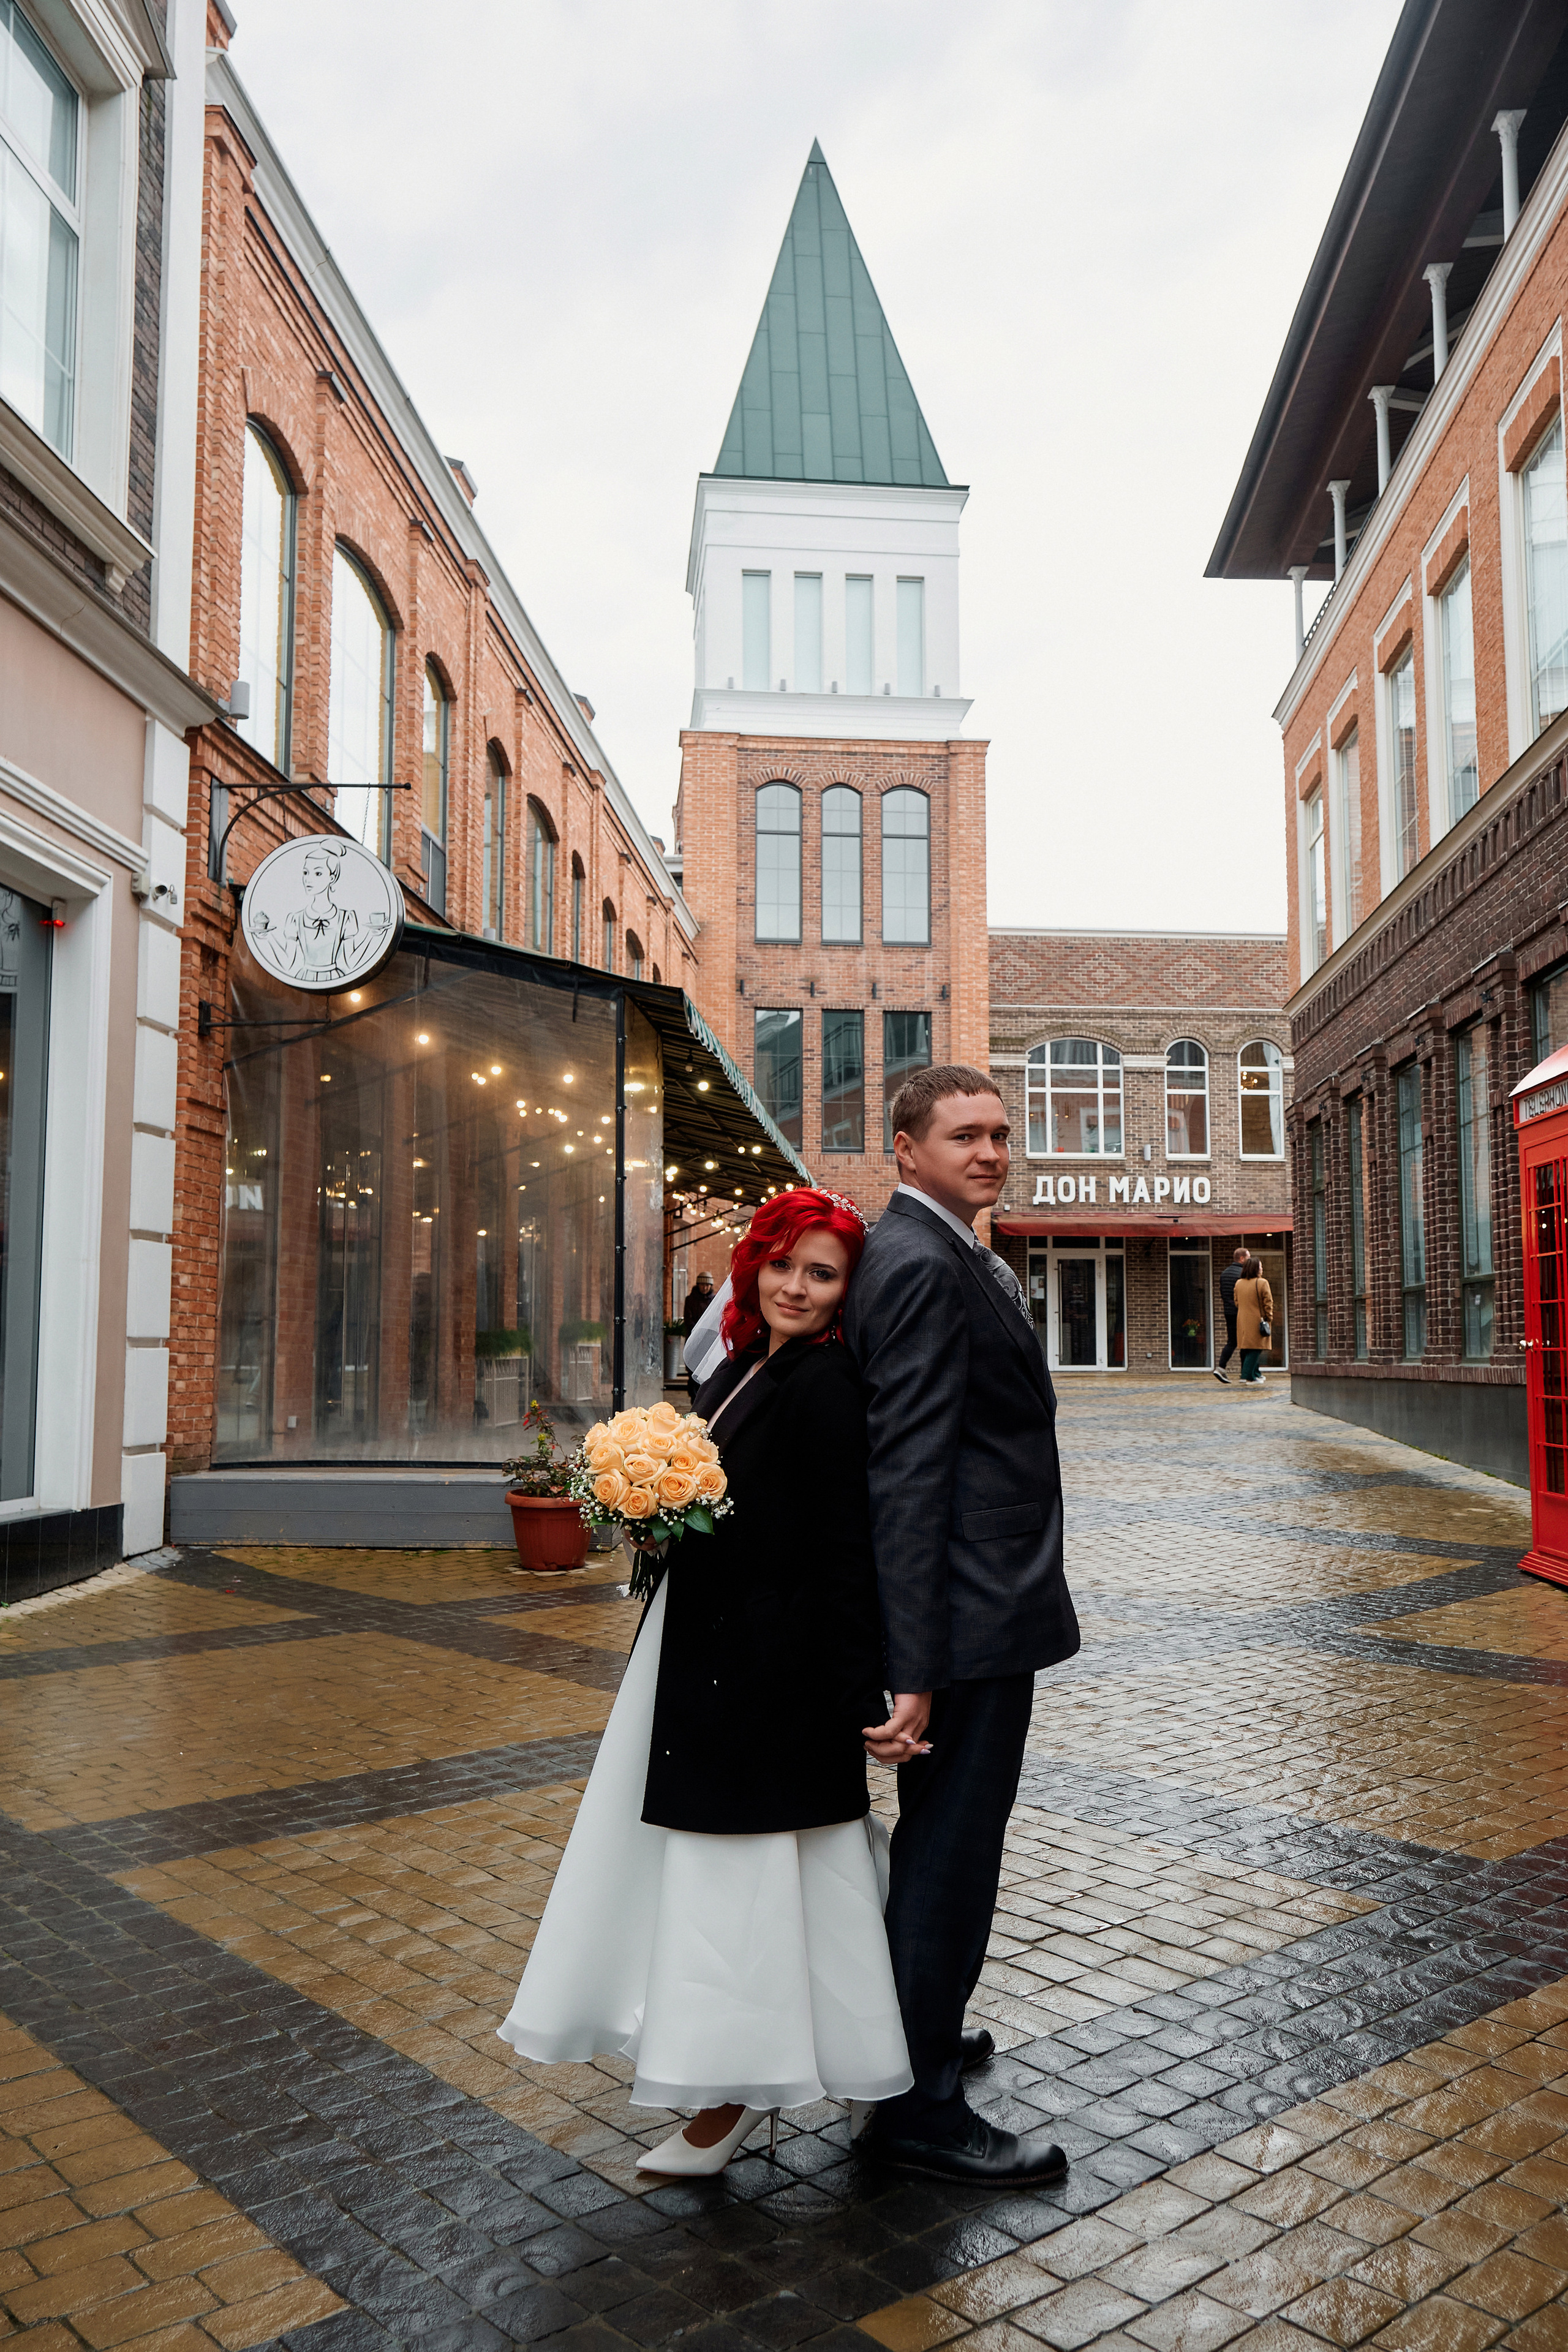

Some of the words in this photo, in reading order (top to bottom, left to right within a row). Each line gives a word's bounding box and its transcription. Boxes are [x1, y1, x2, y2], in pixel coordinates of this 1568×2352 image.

[1523, 1081, 1568, 1120] TELEPHON
[1033, 1175, 1096, 1205] ДОН
[1109, 1176, 1211, 1204] МАРИО
